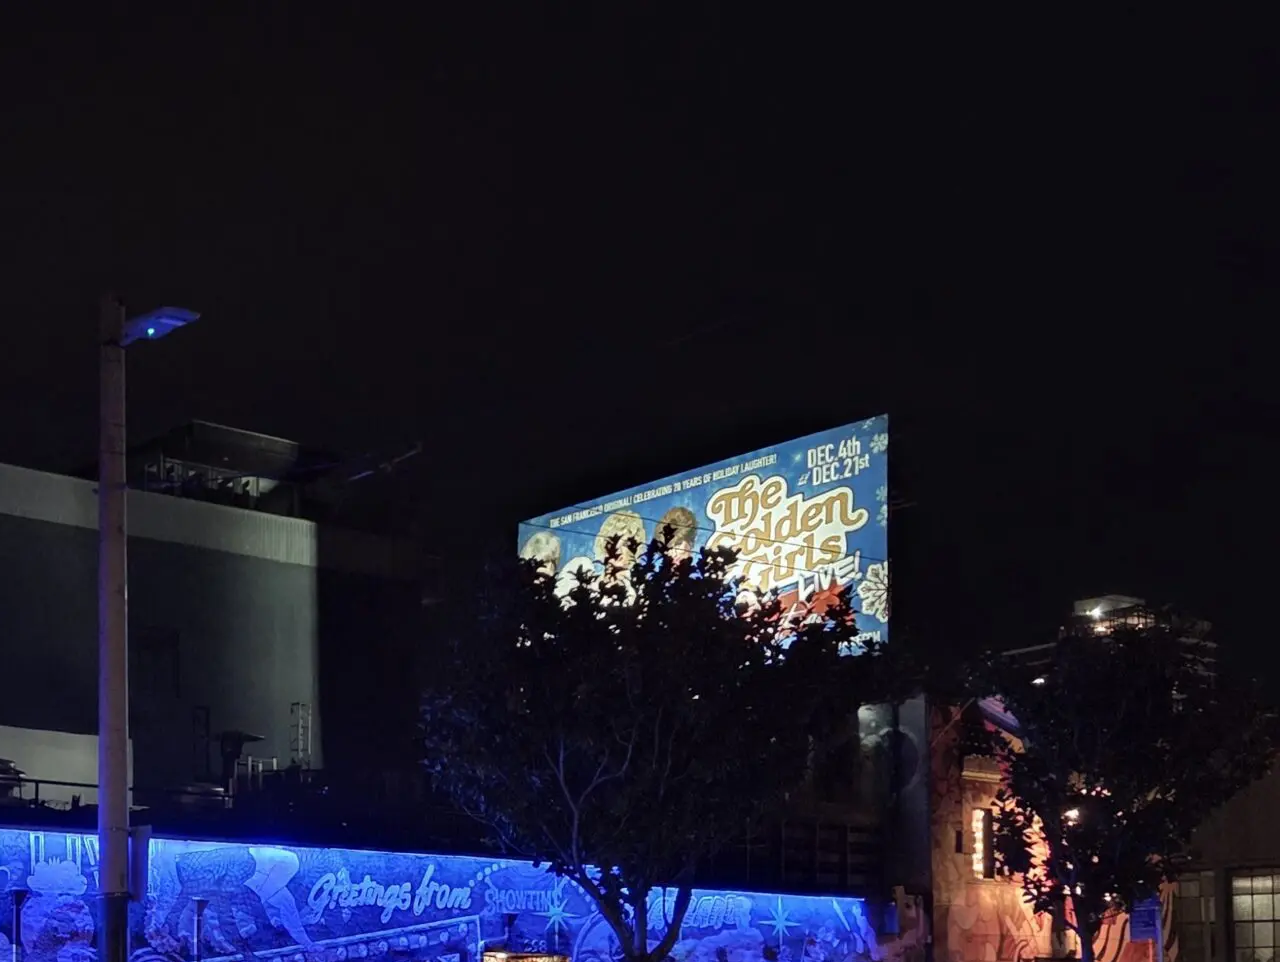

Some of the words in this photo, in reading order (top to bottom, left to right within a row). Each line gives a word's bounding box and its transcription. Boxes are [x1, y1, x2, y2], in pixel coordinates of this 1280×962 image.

[561, 514, 573, 526] SAN
[633, 484, 674, 504] CELEBRATING
[682, 475, 703, 490] YEARS
[703, 472, 713, 484] OF
[713, 464, 740, 480] HOLIDAY
[740, 454, 777, 473] LAUGHTER!
[711, 479, 782, 530] The
[738, 533, 842, 594] Girls
[798, 550, 862, 602] LIVE!
[307, 872, 412, 924] Greetings
[413, 864, 472, 916] from
